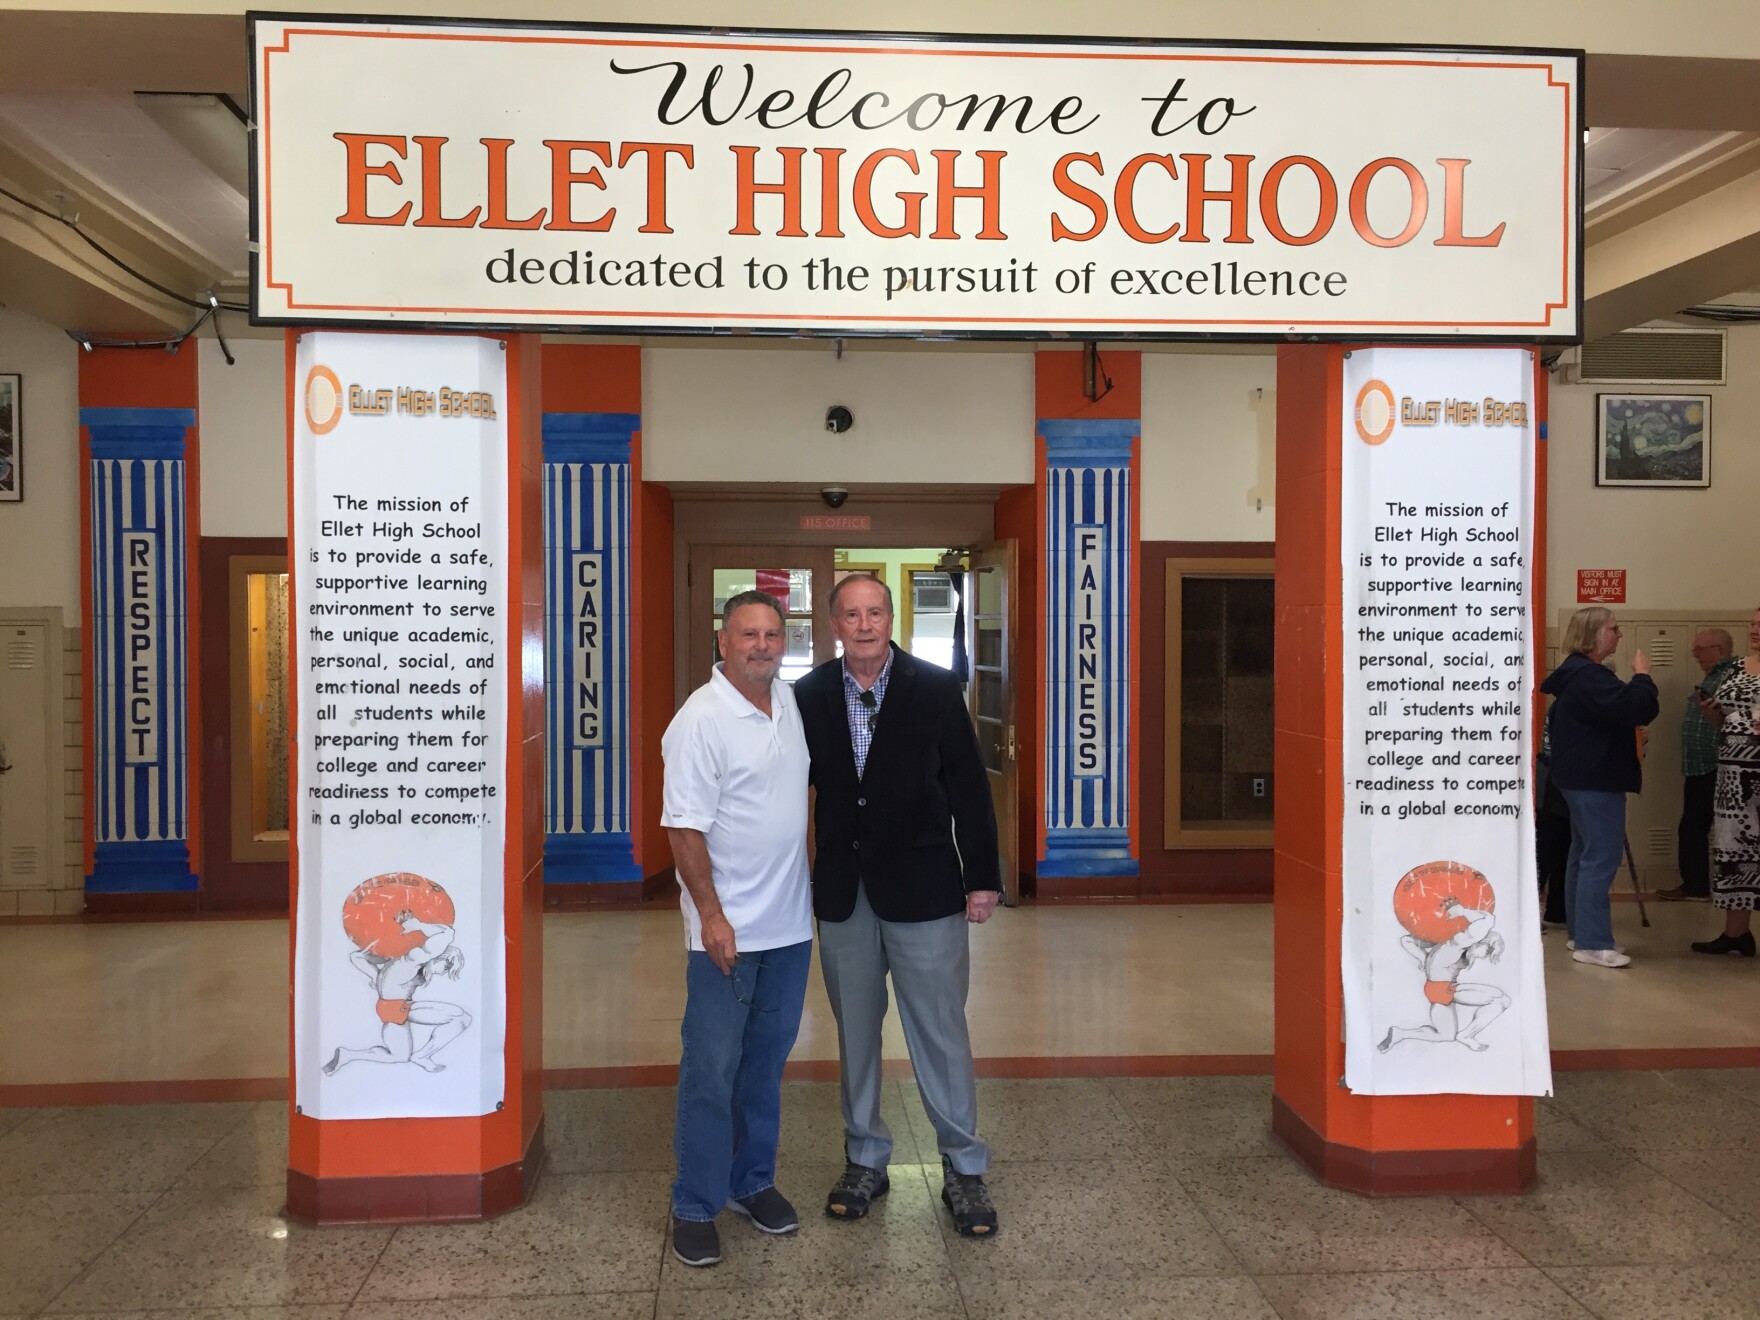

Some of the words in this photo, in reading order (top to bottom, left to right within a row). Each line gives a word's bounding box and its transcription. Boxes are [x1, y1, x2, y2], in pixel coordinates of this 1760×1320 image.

[610, 60, 1100, 134] Welcome
[1142, 79, 1256, 136] to
[334, 132, 694, 234] ELLET
[729, 144, 1007, 242] HIGH
[1051, 151, 1506, 248] SCHOOL
[486, 249, 724, 288] dedicated
[744, 258, 787, 290] to
[802, 258, 868, 291] the
[884, 260, 1037, 300] pursuit
[1056, 262, 1095, 293] of
[1111, 262, 1346, 296] excellence
[332, 494, 368, 511] The
[377, 496, 442, 512] mission
[449, 496, 469, 513] of
[1385, 501, 1417, 517] The
[1425, 502, 1484, 518] mission
[1491, 501, 1509, 518] of
[321, 520, 364, 537] Ellet
[372, 521, 414, 542] High
[422, 522, 481, 539] School
[825, 519, 865, 528] OFFICE
[1374, 526, 1413, 542] Ellet
[1420, 526, 1458, 547] High
[1465, 526, 1519, 542] School
[310, 547, 319, 563] is
[327, 548, 347, 563] to
[356, 548, 422, 568] provide
[430, 553, 441, 565] a
[449, 548, 493, 568] safe,
[1359, 552, 1372, 567] is
[1380, 553, 1398, 567] to
[1405, 551, 1465, 571] provide
[1472, 556, 1483, 567] a
[315, 574, 409, 594] supportive
[417, 574, 488, 596] learning
[1367, 577, 1453, 596] supportive
[1461, 576, 1523, 597] learning
[309, 601, 415, 617] environment
[422, 602, 442, 617] to
[450, 605, 496, 617] serve
[1357, 602, 1458, 617] environment
[1465, 603, 1483, 617] to
[309, 625, 334, 642] the
[343, 626, 400, 647] unique
[408, 626, 494, 646] academic,
[1357, 626, 1385, 642] the
[1393, 627, 1444, 646] unique
[130, 539, 150, 756] RESPECT
[579, 561, 598, 739] CARING
[1079, 534, 1097, 769] FAIRNESS
[310, 652, 388, 672] personal,
[398, 652, 455, 671] social,
[465, 652, 494, 669] and
[1359, 651, 1434, 671] personal,
[1443, 651, 1494, 669] social,
[315, 678, 400, 695] emotional
[409, 678, 461, 695] needs
[469, 678, 488, 696] of
[1366, 675, 1445, 692] emotional
[1452, 676, 1500, 692] needs
[1507, 675, 1522, 692] of
[316, 704, 337, 721] all
[354, 704, 433, 721] students
[441, 704, 486, 721] while
[1368, 701, 1387, 716] all
[1402, 700, 1474, 716] students
[1481, 700, 1521, 716] while
[314, 731, 399, 752] preparing
[407, 730, 453, 747] them
[461, 730, 489, 748] for
[1365, 726, 1444, 746] preparing
[1450, 725, 1493, 742] them
[1499, 725, 1523, 742] for
[316, 756, 378, 778] college
[386, 756, 419, 773] and
[426, 761, 487, 773] career
[1367, 750, 1424, 771] college
[1431, 750, 1461, 766] and
[1467, 754, 1522, 766] career
[308, 782, 389, 799] readiness
[397, 784, 417, 799] to
[424, 783, 497, 803] compete
[1355, 775, 1435, 791] readiness
[1441, 777, 1459, 791] to
[311, 809, 322, 825] in
[329, 814, 341, 825] a
[348, 808, 402, 830] global
[1360, 800, 1374, 816] in
[1381, 804, 1391, 816] a
[1398, 799, 1446, 820] global
